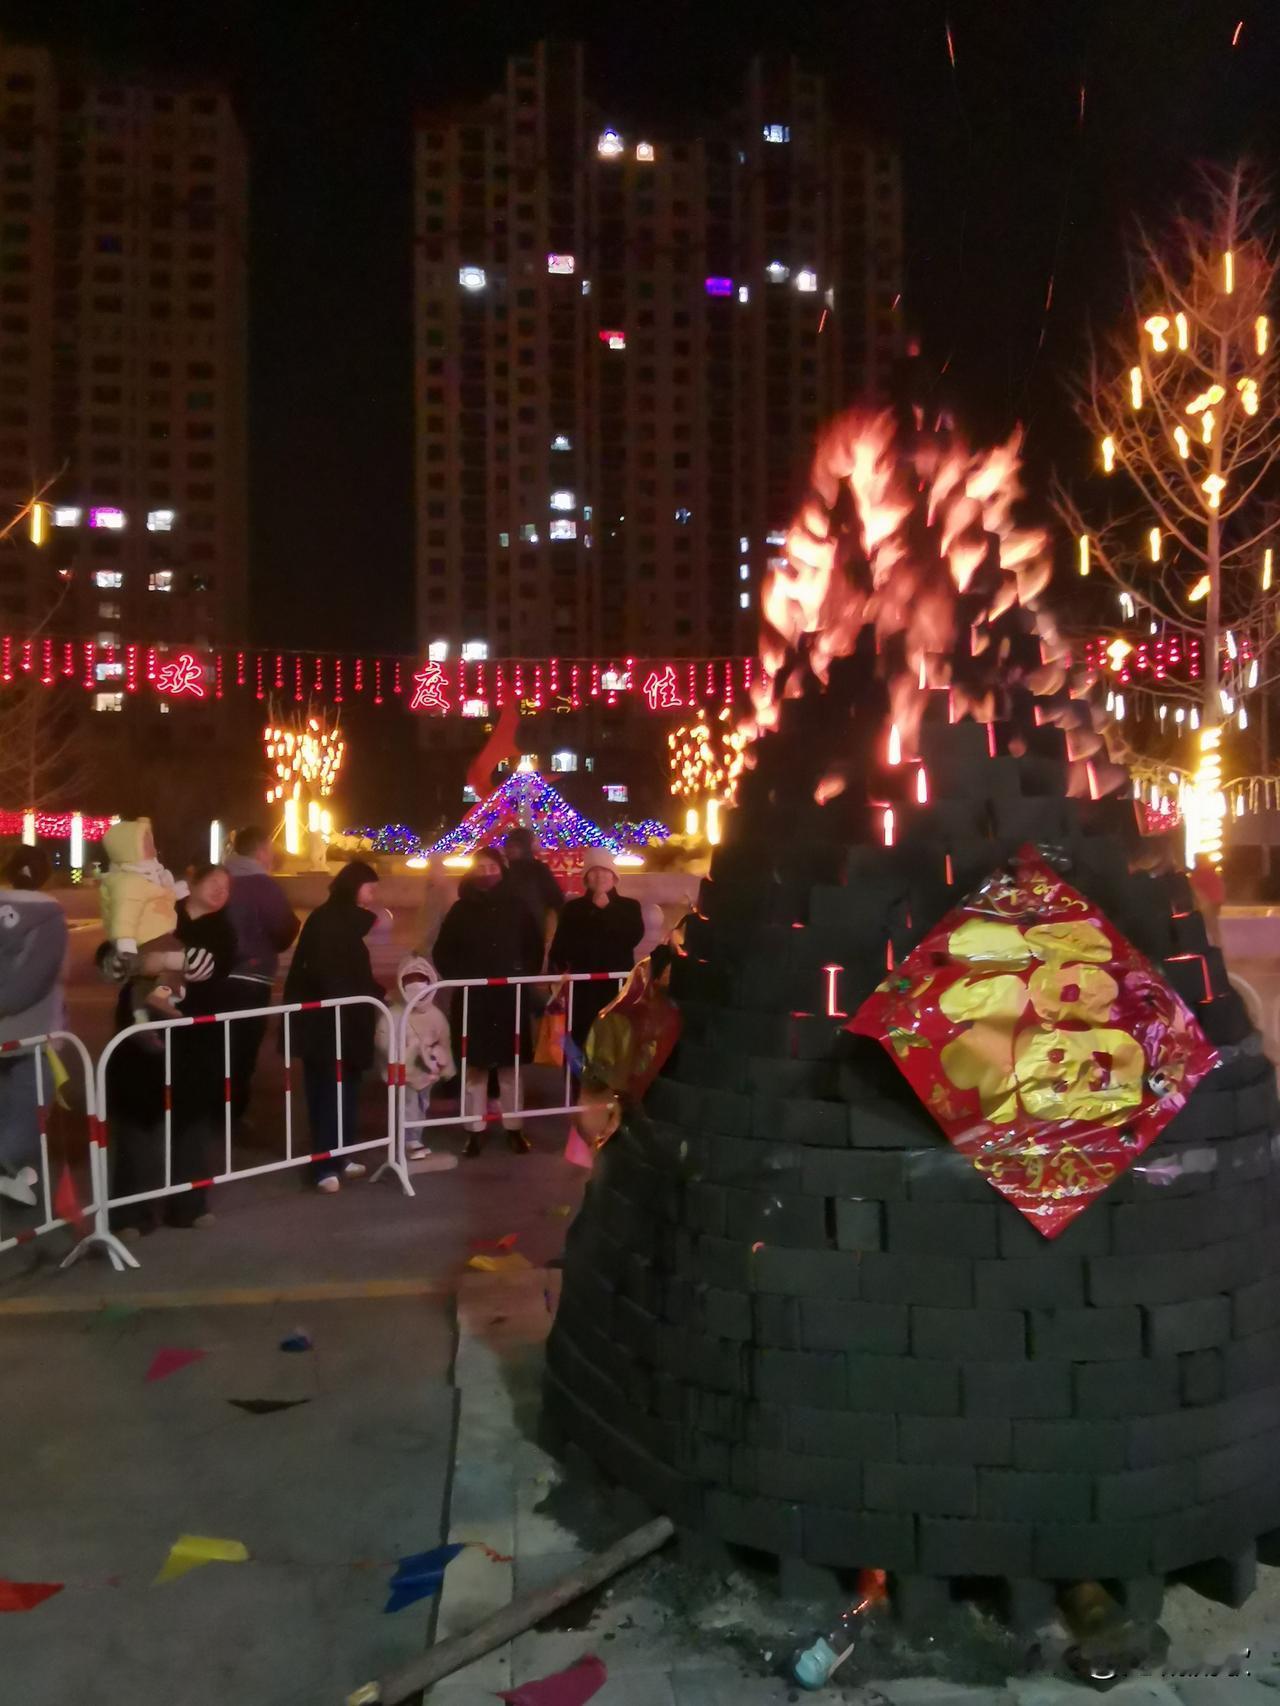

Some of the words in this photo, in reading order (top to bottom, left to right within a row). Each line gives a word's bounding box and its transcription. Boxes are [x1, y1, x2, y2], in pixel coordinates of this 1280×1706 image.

[156, 654, 204, 697] 欢
[410, 661, 451, 710] 度
[643, 666, 683, 710] 佳
[938, 918, 1145, 1126] 福
